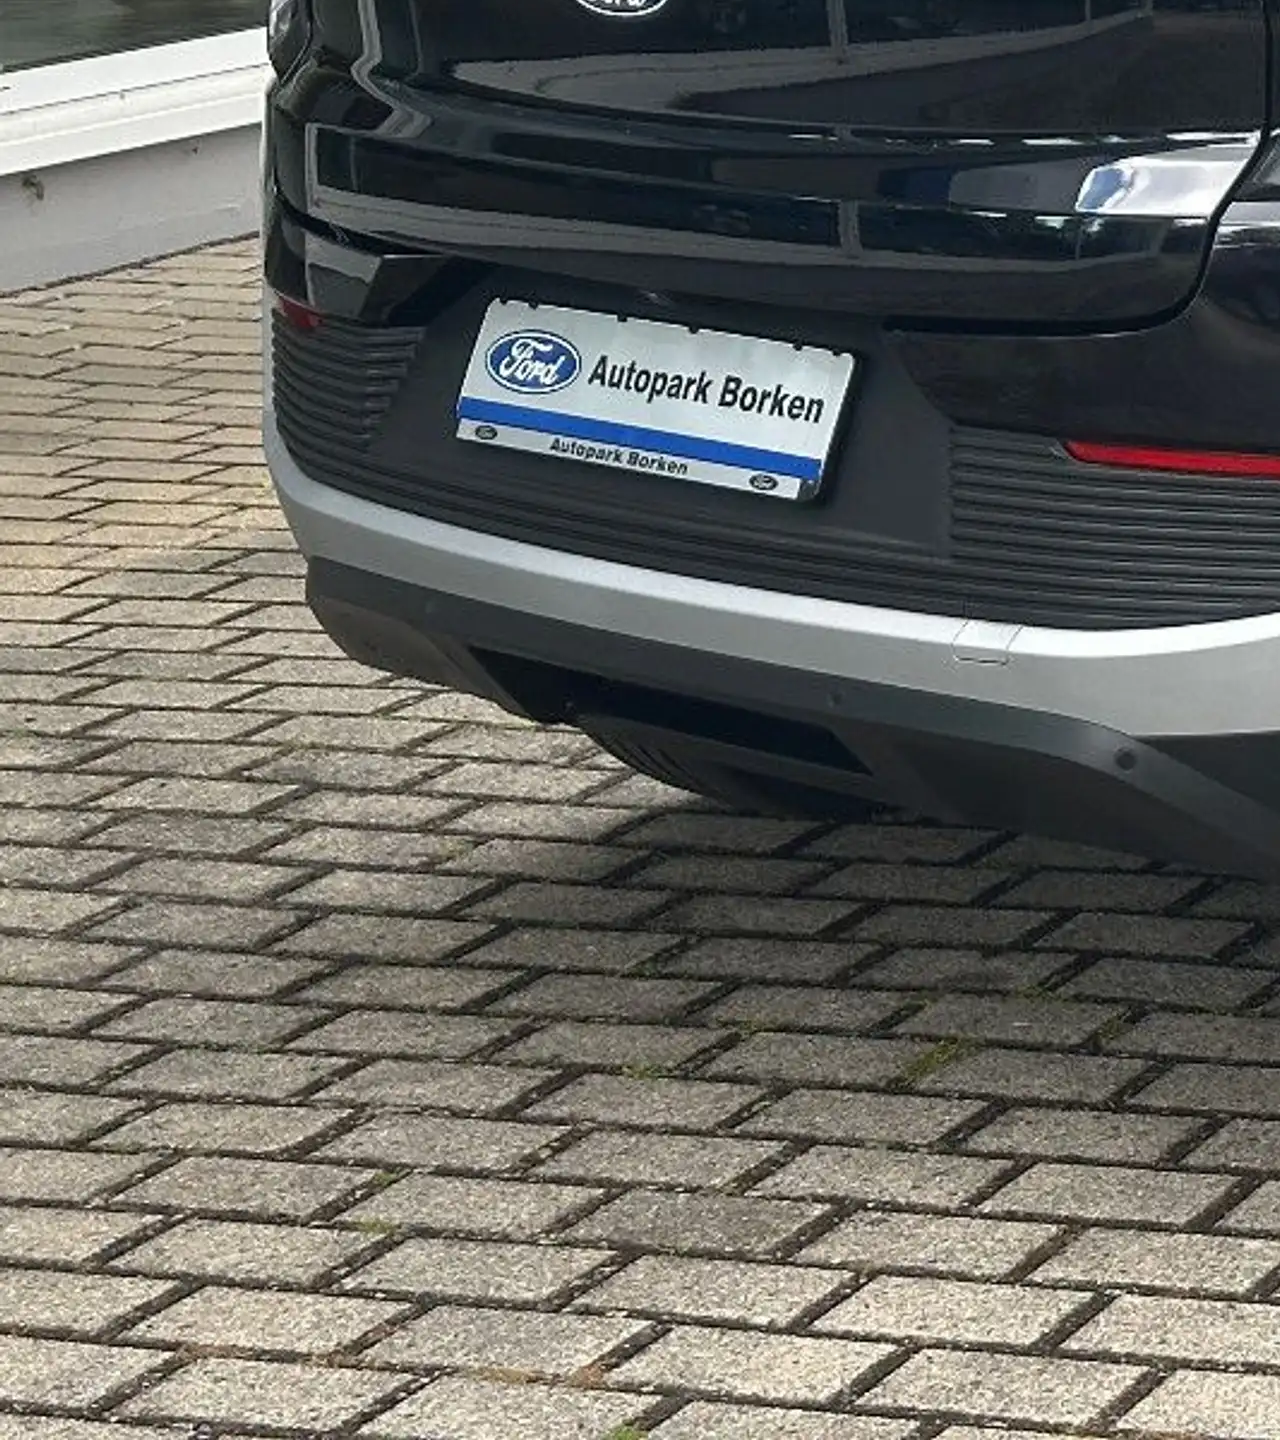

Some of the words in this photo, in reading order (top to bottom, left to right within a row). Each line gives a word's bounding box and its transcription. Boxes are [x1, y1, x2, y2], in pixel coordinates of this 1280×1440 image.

[499, 339, 566, 385] Ford
[588, 355, 711, 403] Autopark
[718, 375, 825, 424] Borken
[550, 436, 623, 464] Autopark
[627, 451, 688, 476] Borken
